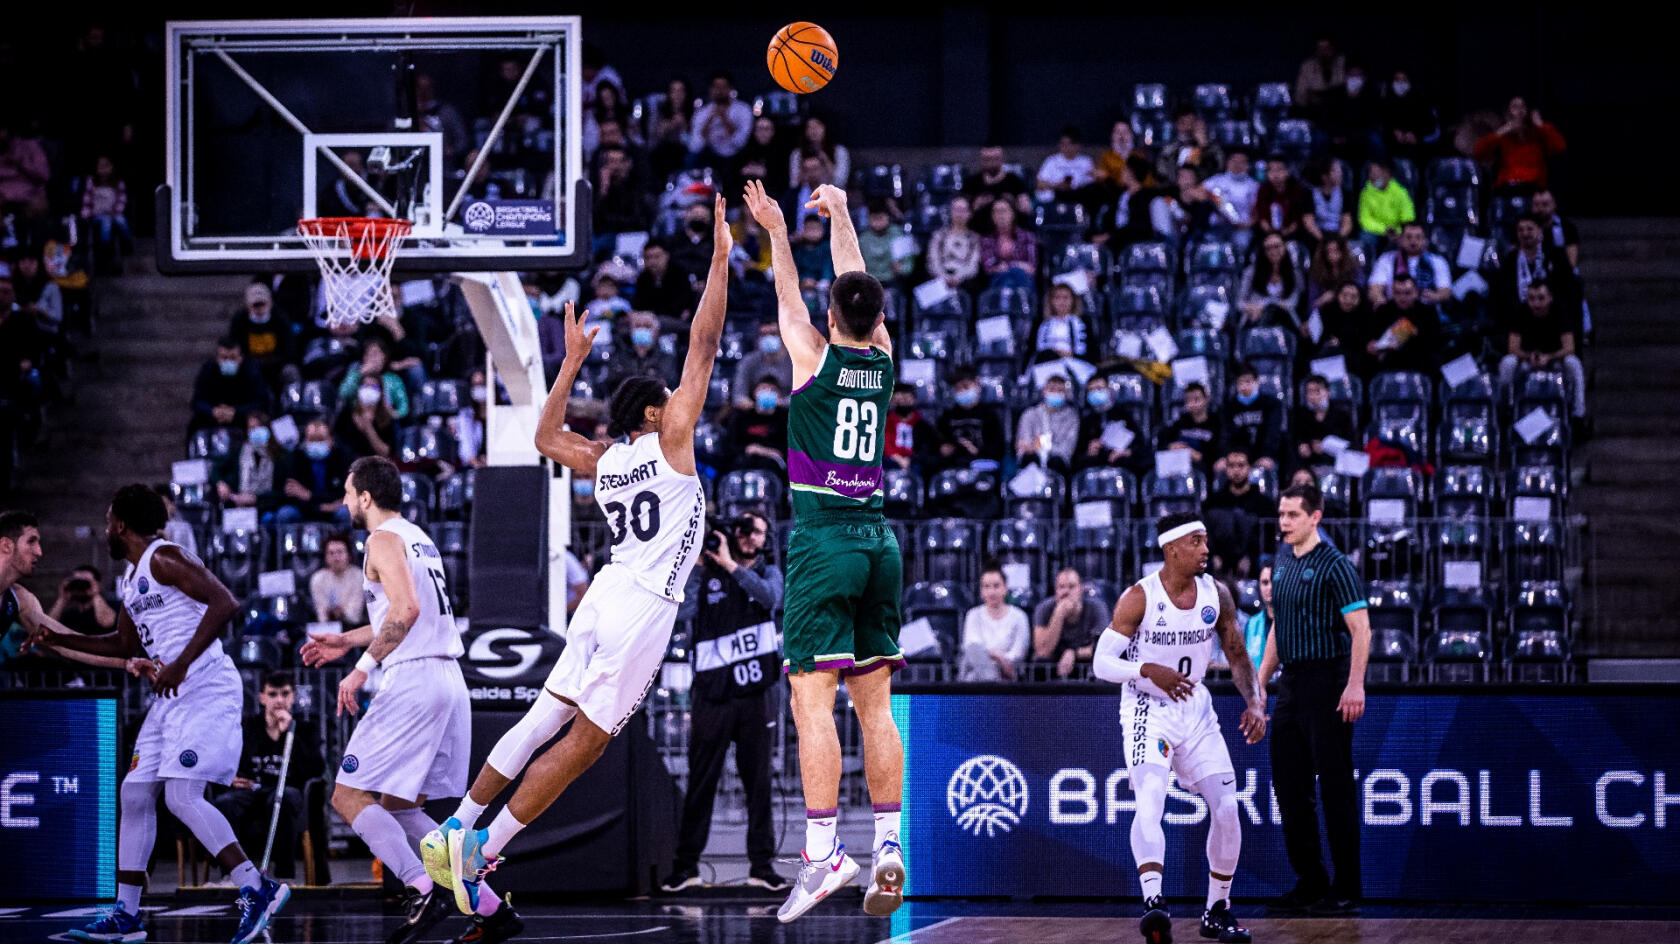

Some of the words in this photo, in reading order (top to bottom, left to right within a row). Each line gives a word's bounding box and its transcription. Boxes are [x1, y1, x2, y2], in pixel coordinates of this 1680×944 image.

[837, 367, 883, 389] BOUTEILLE
[833, 398, 879, 461] 83
[600, 460, 658, 491] STEWART
[604, 490, 661, 547] 30
[733, 660, 763, 687] 08
[1178, 656, 1192, 678] 0
[1050, 767, 1574, 827] BASKBALL
